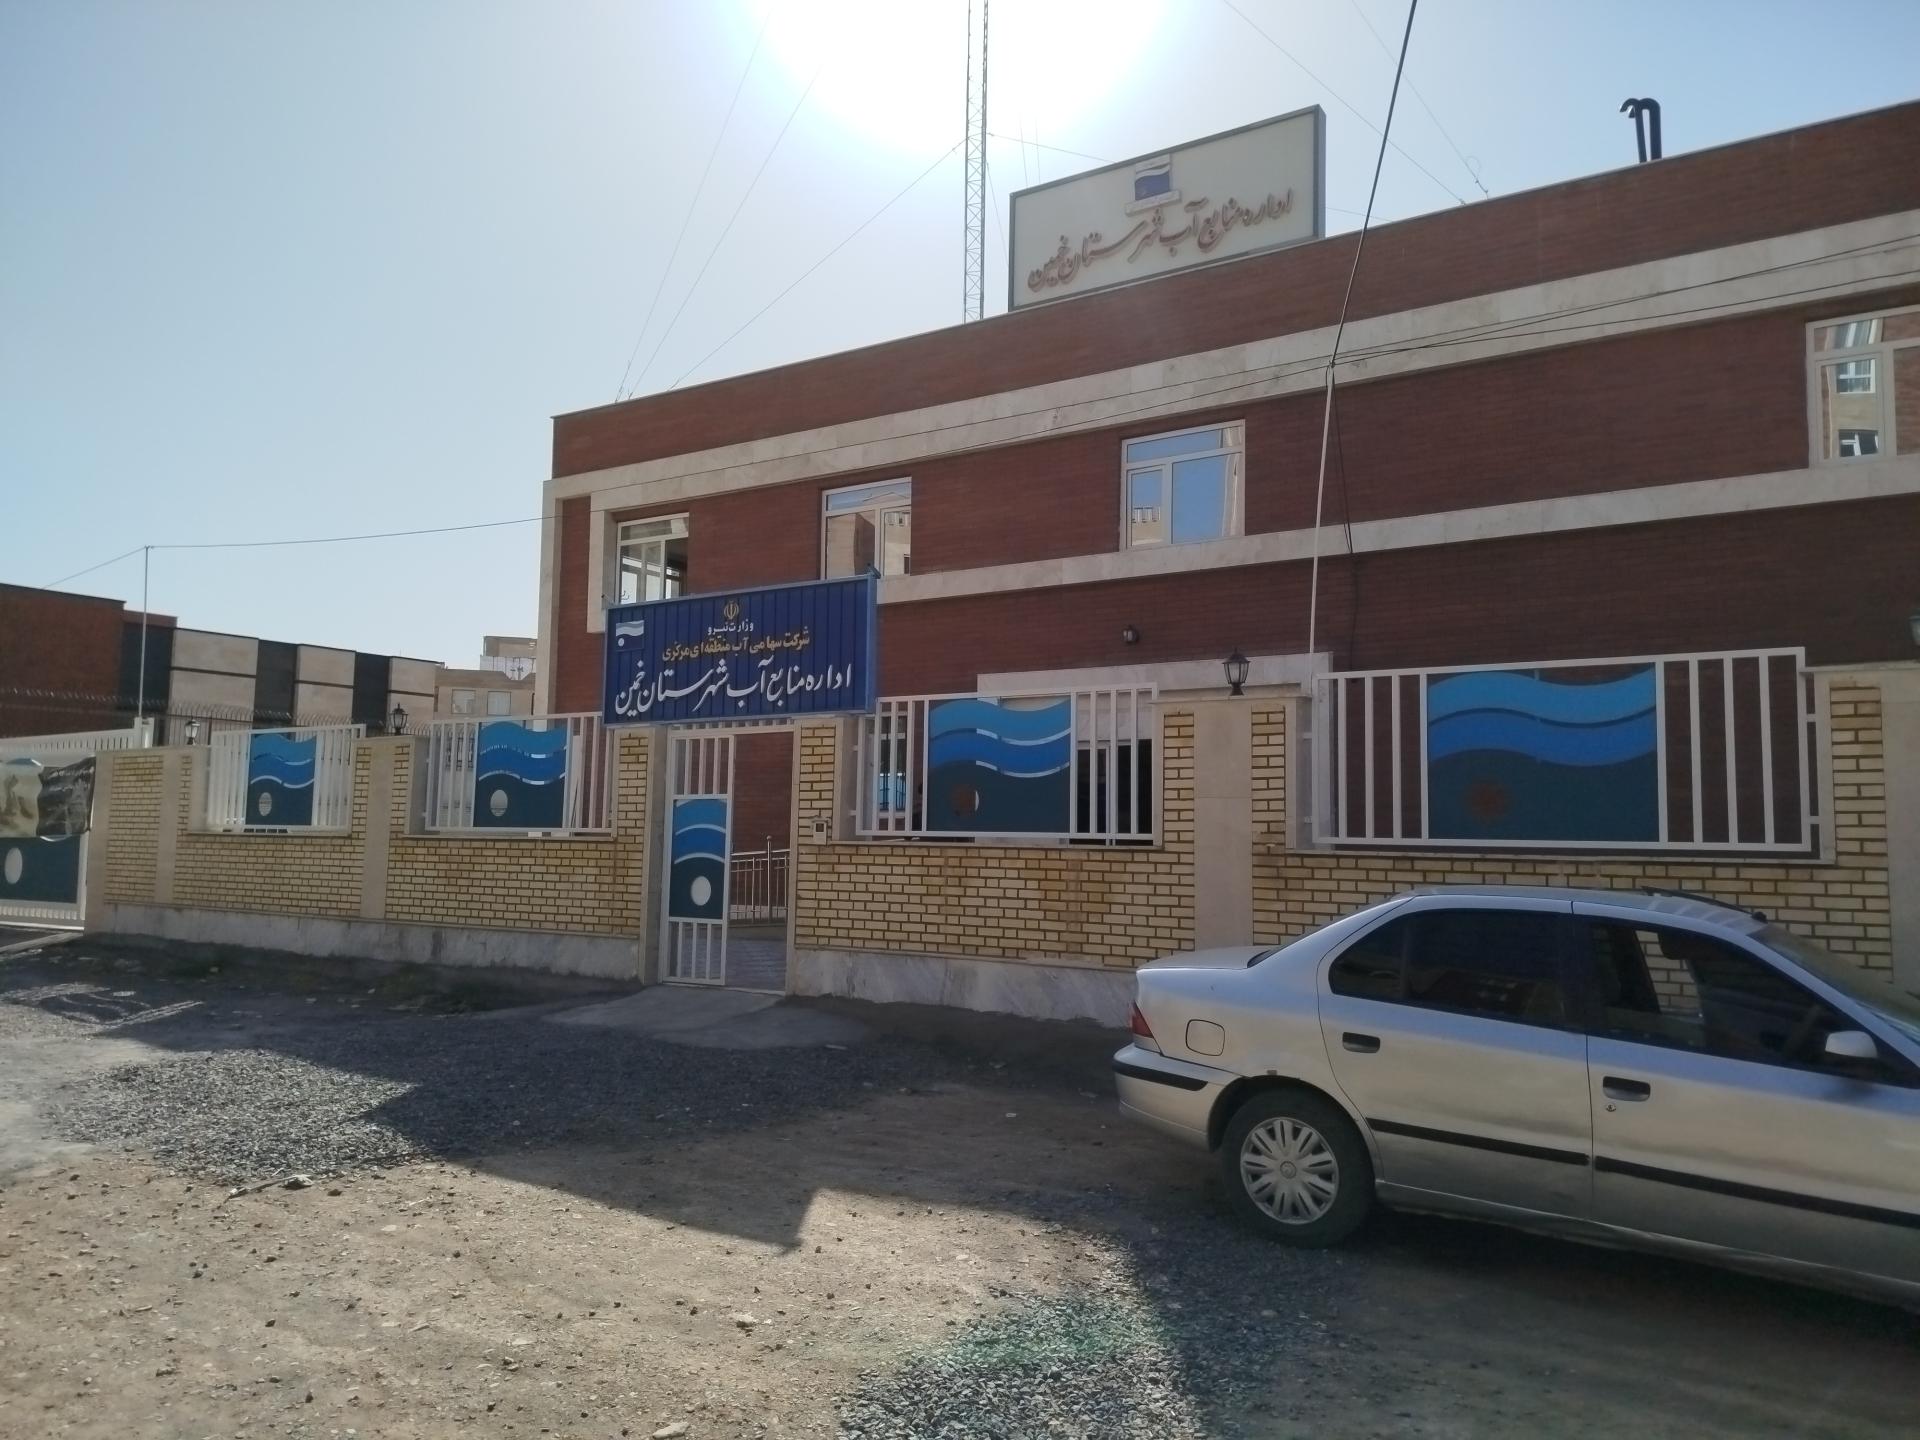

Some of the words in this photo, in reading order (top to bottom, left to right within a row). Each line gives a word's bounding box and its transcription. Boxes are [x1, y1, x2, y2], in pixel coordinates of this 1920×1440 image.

[1159, 197, 1209, 257] آب
[1197, 197, 1244, 253] منابع
[1241, 187, 1294, 227] اداره
[1027, 235, 1070, 292] خمین
[1058, 208, 1164, 284] شهرستان
[707, 621, 729, 639] نیرو
[728, 618, 754, 633] وزارت
[750, 635, 783, 653] سهامی
[782, 625, 811, 650] شرکت
[662, 641, 692, 662] مرکزی
[732, 637, 749, 656] آب
[615, 660, 646, 717] خمین
[637, 658, 730, 713] شهرستان
[726, 655, 775, 708] آب
[766, 665, 806, 707] منابع
[805, 663, 852, 691] اداره
